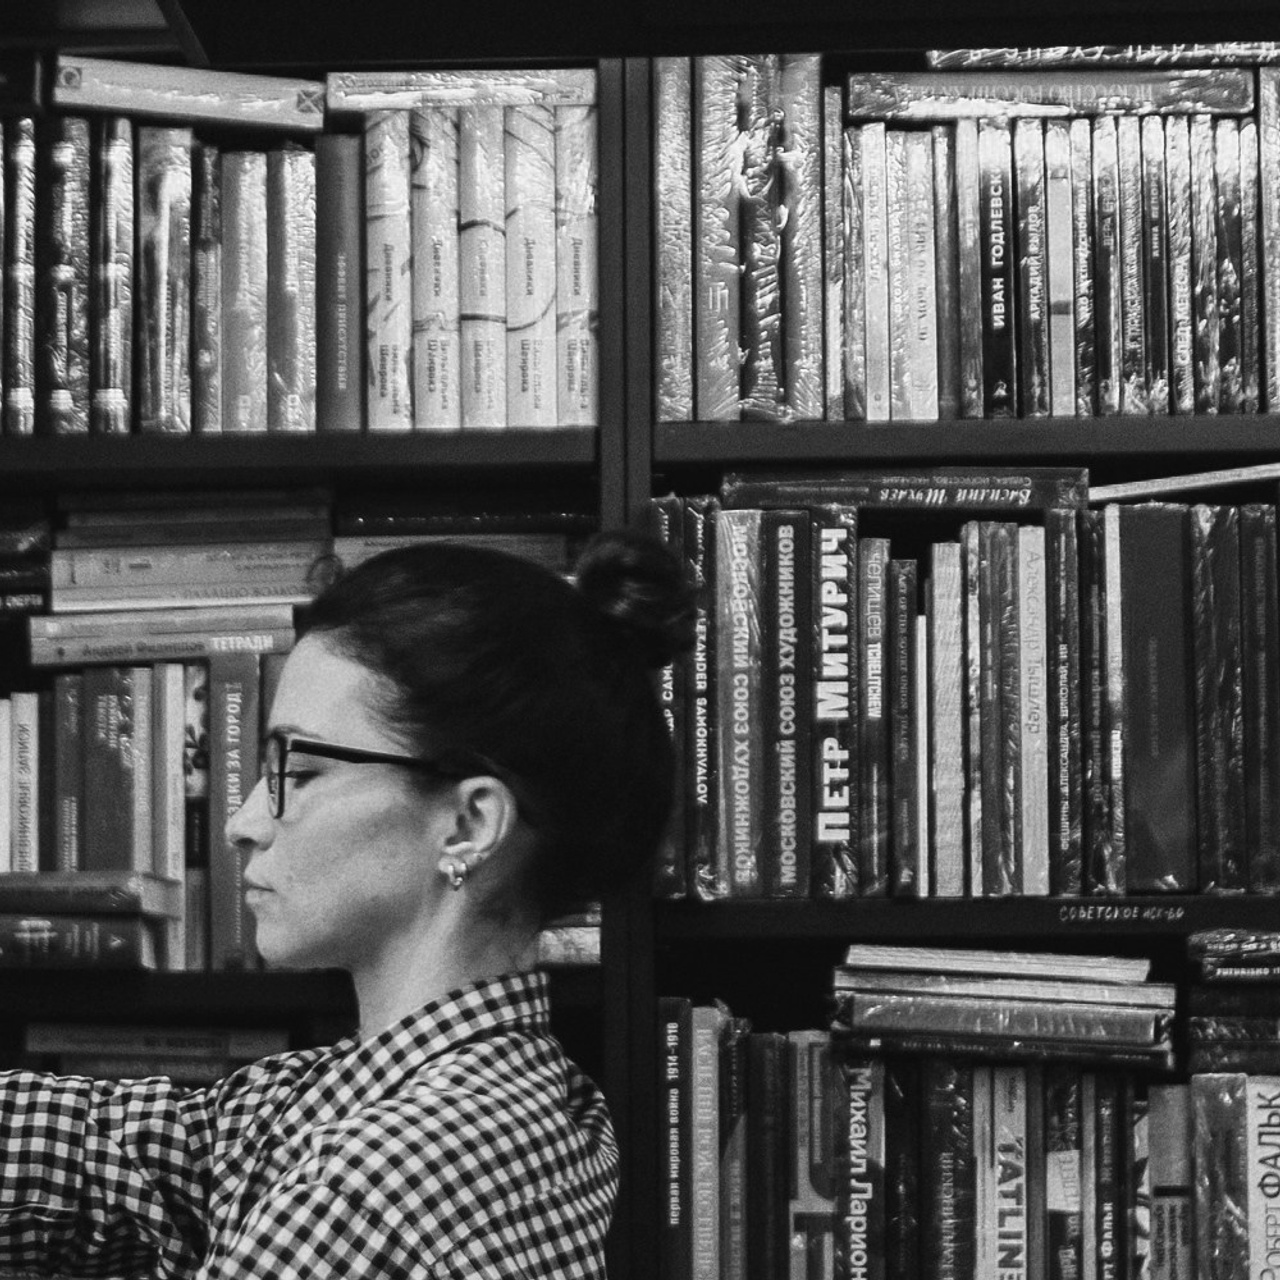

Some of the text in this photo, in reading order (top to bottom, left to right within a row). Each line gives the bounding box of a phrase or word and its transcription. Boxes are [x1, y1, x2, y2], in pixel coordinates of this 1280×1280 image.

[990, 167, 1006, 329] ИВАН ГОДЛЕВСК
[210, 634, 277, 651] ТЕТРАДИ
[1024, 656, 1045, 735] Тышлер
[225, 692, 242, 743] ГОРОД
[225, 748, 242, 769] ЗА
[695, 696, 709, 804] SAMOKHVALOV
[731, 525, 752, 885] МОСКОВСКИЙ СОЮЗ ХУДОЖНИКОВ
[777, 524, 799, 886] МОСКОВСКИЙ СОЮЗ ХУДОЖНИКОВ
[669, 1127, 682, 1179] мировая
[846, 1066, 874, 1174] Михаил
[1257, 1091, 1280, 1200] ФАЛЬК
[998, 1136, 1024, 1269] TATLIN
